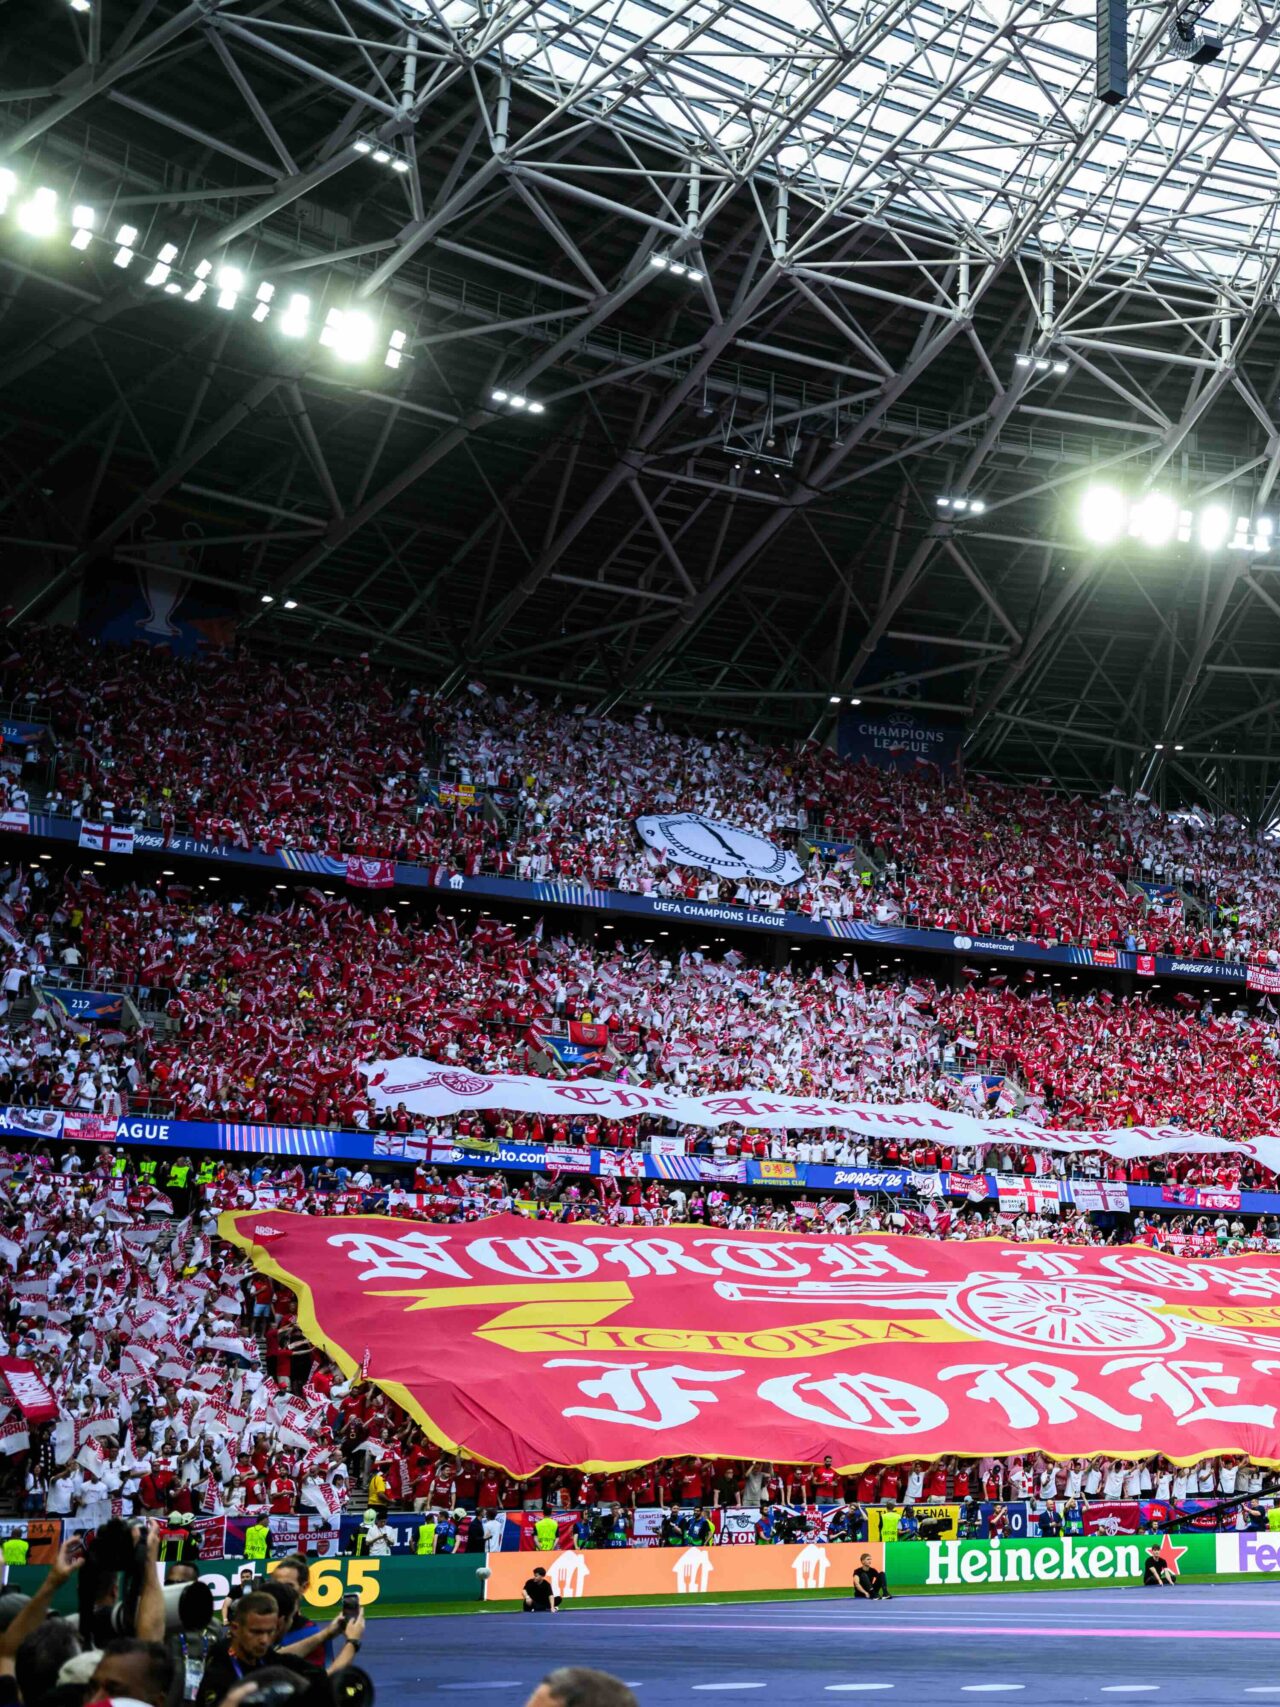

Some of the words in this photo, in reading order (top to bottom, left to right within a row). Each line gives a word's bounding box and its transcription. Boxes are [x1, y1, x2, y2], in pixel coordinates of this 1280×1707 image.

[858, 724, 944, 743] CHAMPIONS
[873, 738, 929, 753] LEAGUE
[646, 829, 655, 837] 9
[184, 840, 229, 857] FINAL
[667, 848, 678, 857] 8
[653, 901, 682, 914] UEFA
[683, 905, 744, 921] CHAMPIONS
[747, 913, 785, 927] LEAGUE
[974, 940, 1015, 952] mastercard
[1171, 961, 1203, 973] BUDAPEST
[1215, 966, 1245, 977] FINAL
[71, 998, 90, 1009] 212
[563, 1046, 578, 1055] 211
[547, 1085, 678, 1111] The
[702, 1097, 954, 1131] Arsenal
[983, 1127, 1117, 1146] since
[116, 1123, 169, 1141] AGUE
[547, 1146, 589, 1154] ARSENAL
[547, 1163, 590, 1171] CHAMPIONS
[35, 1174, 124, 1190] YRSHIE
[752, 1178, 790, 1186] SUPPORTERS
[834, 1171, 886, 1187] BUDAPEST
[327, 1232, 929, 1283] NORTH
[536, 1320, 927, 1354] VICTORIA
[902, 1508, 951, 1518] ASENAL
[298, 1531, 338, 1541] GOONERS
[199, 1549, 222, 1559] CLUB
[925, 1536, 1142, 1585] Heineken
